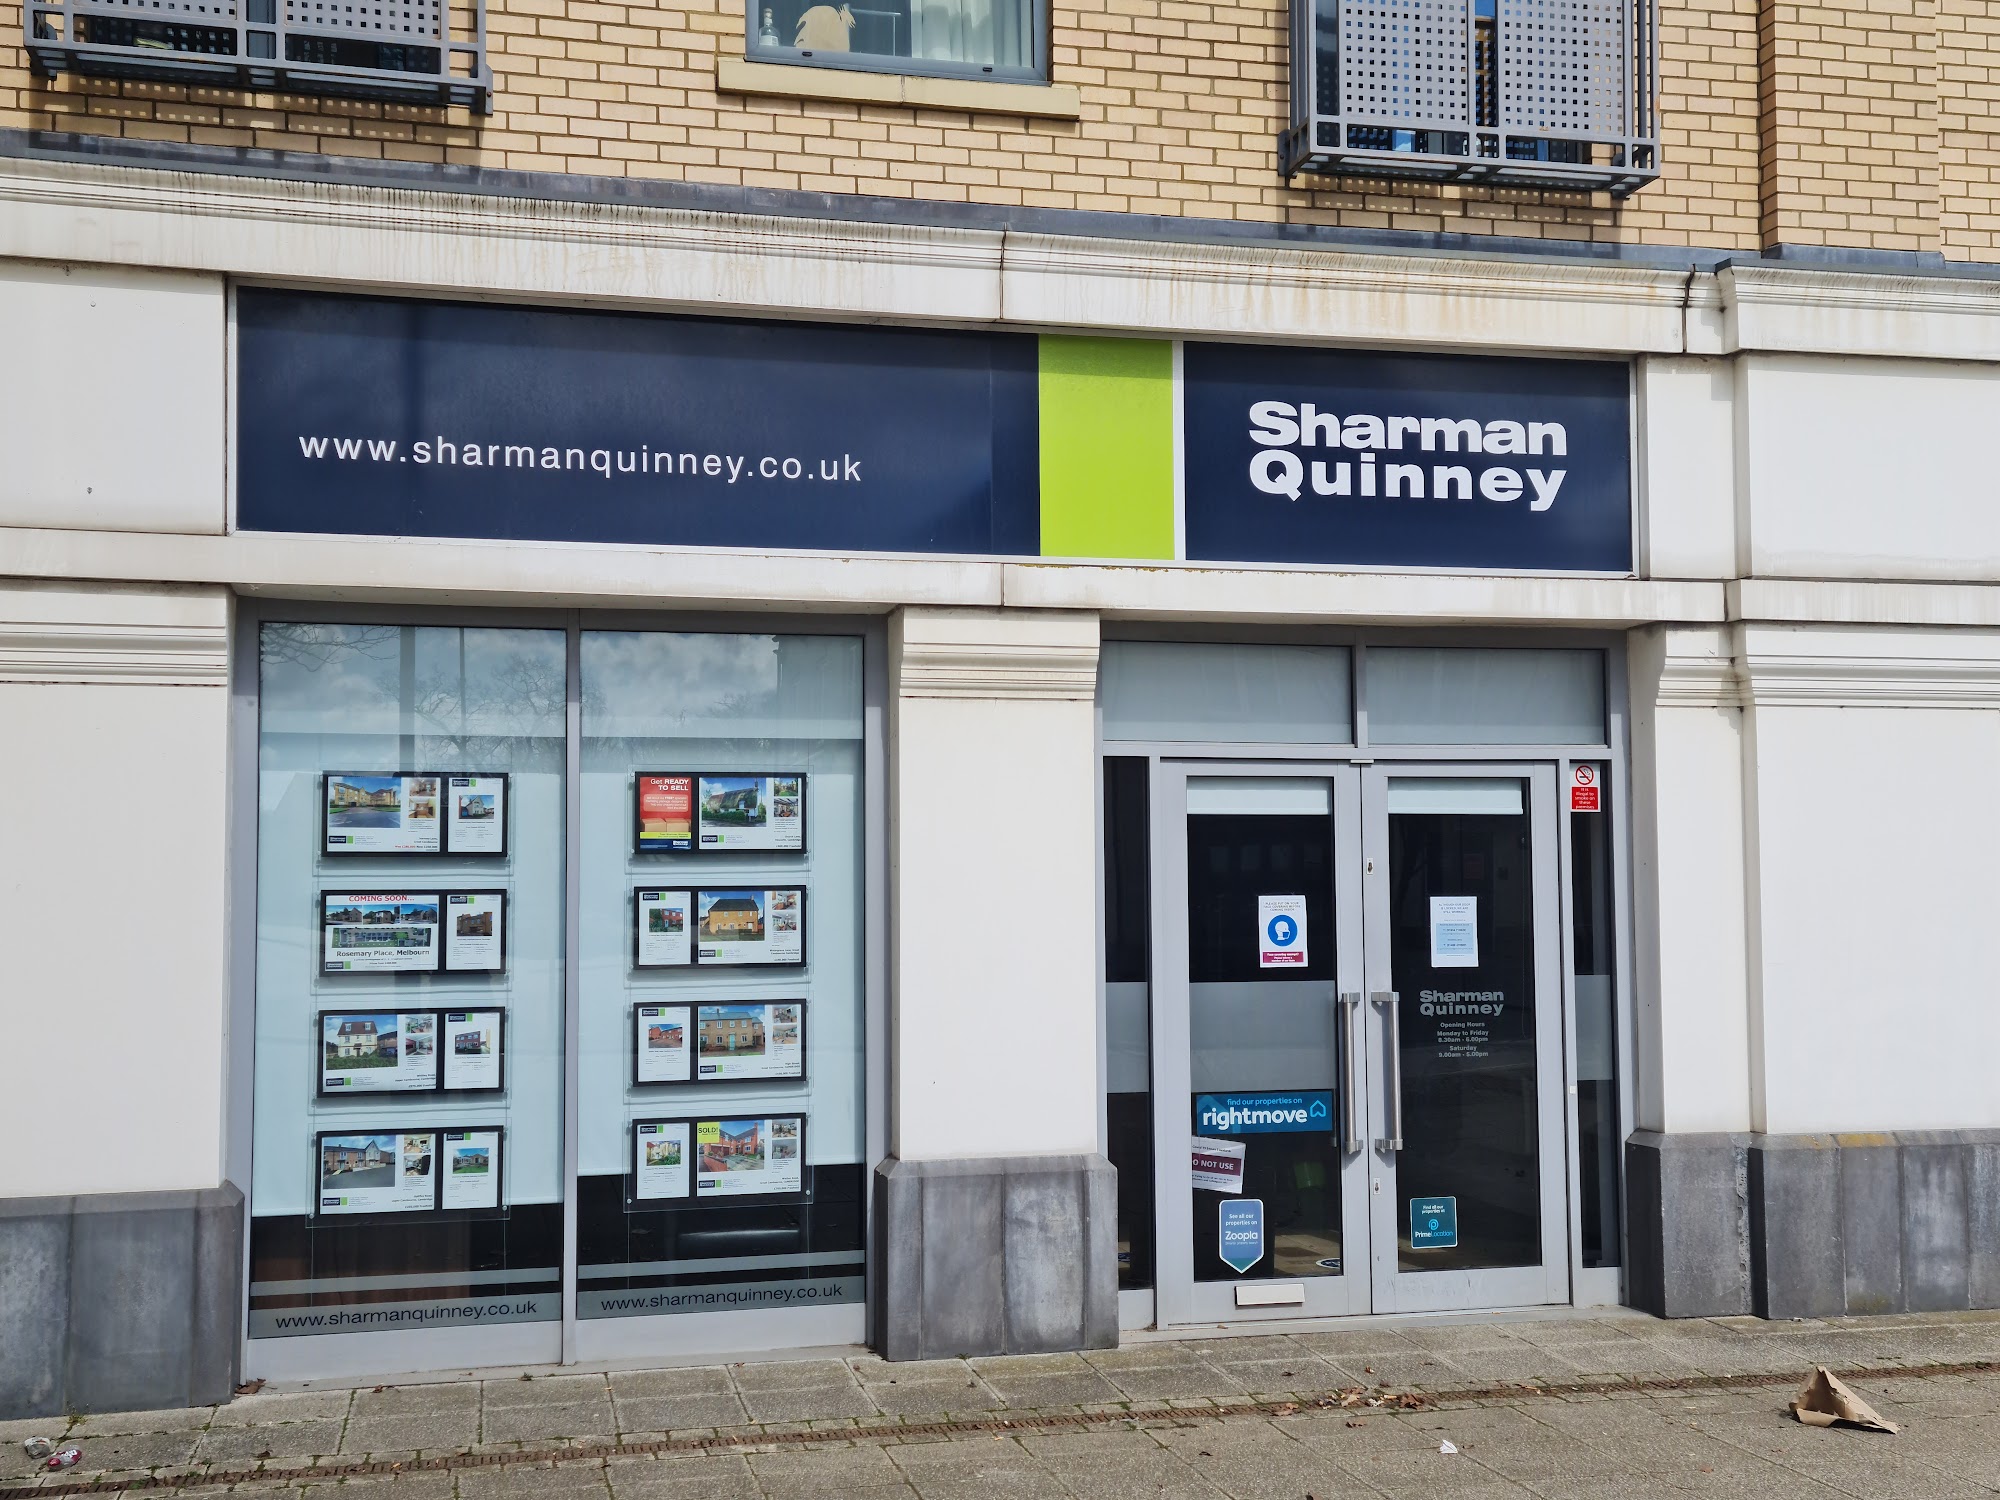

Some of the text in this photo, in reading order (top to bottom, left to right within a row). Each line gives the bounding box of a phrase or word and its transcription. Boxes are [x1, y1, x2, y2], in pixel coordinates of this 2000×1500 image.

[1249, 400, 1567, 456] Sharman
[298, 435, 862, 484] www.sharmanquinney.co.uk
[1249, 449, 1567, 511] Quinney
[336, 950, 372, 958] Rosemary
[373, 949, 395, 957] Place,
[1420, 990, 1504, 1002] Sharman
[1420, 1003, 1504, 1017] Quinney
[1227, 1098, 1241, 1106] find
[1254, 1097, 1292, 1107] properties
[1203, 1107, 1308, 1131] rightmove
[1200, 1160, 1218, 1168] NOT
[1219, 1162, 1235, 1171] USE
[1225, 1231, 1258, 1241] Zoopla
[601, 1284, 842, 1311] www.sharmanquinney.co.uk
[275, 1300, 537, 1329] www.sharmanquinney.co.uk
